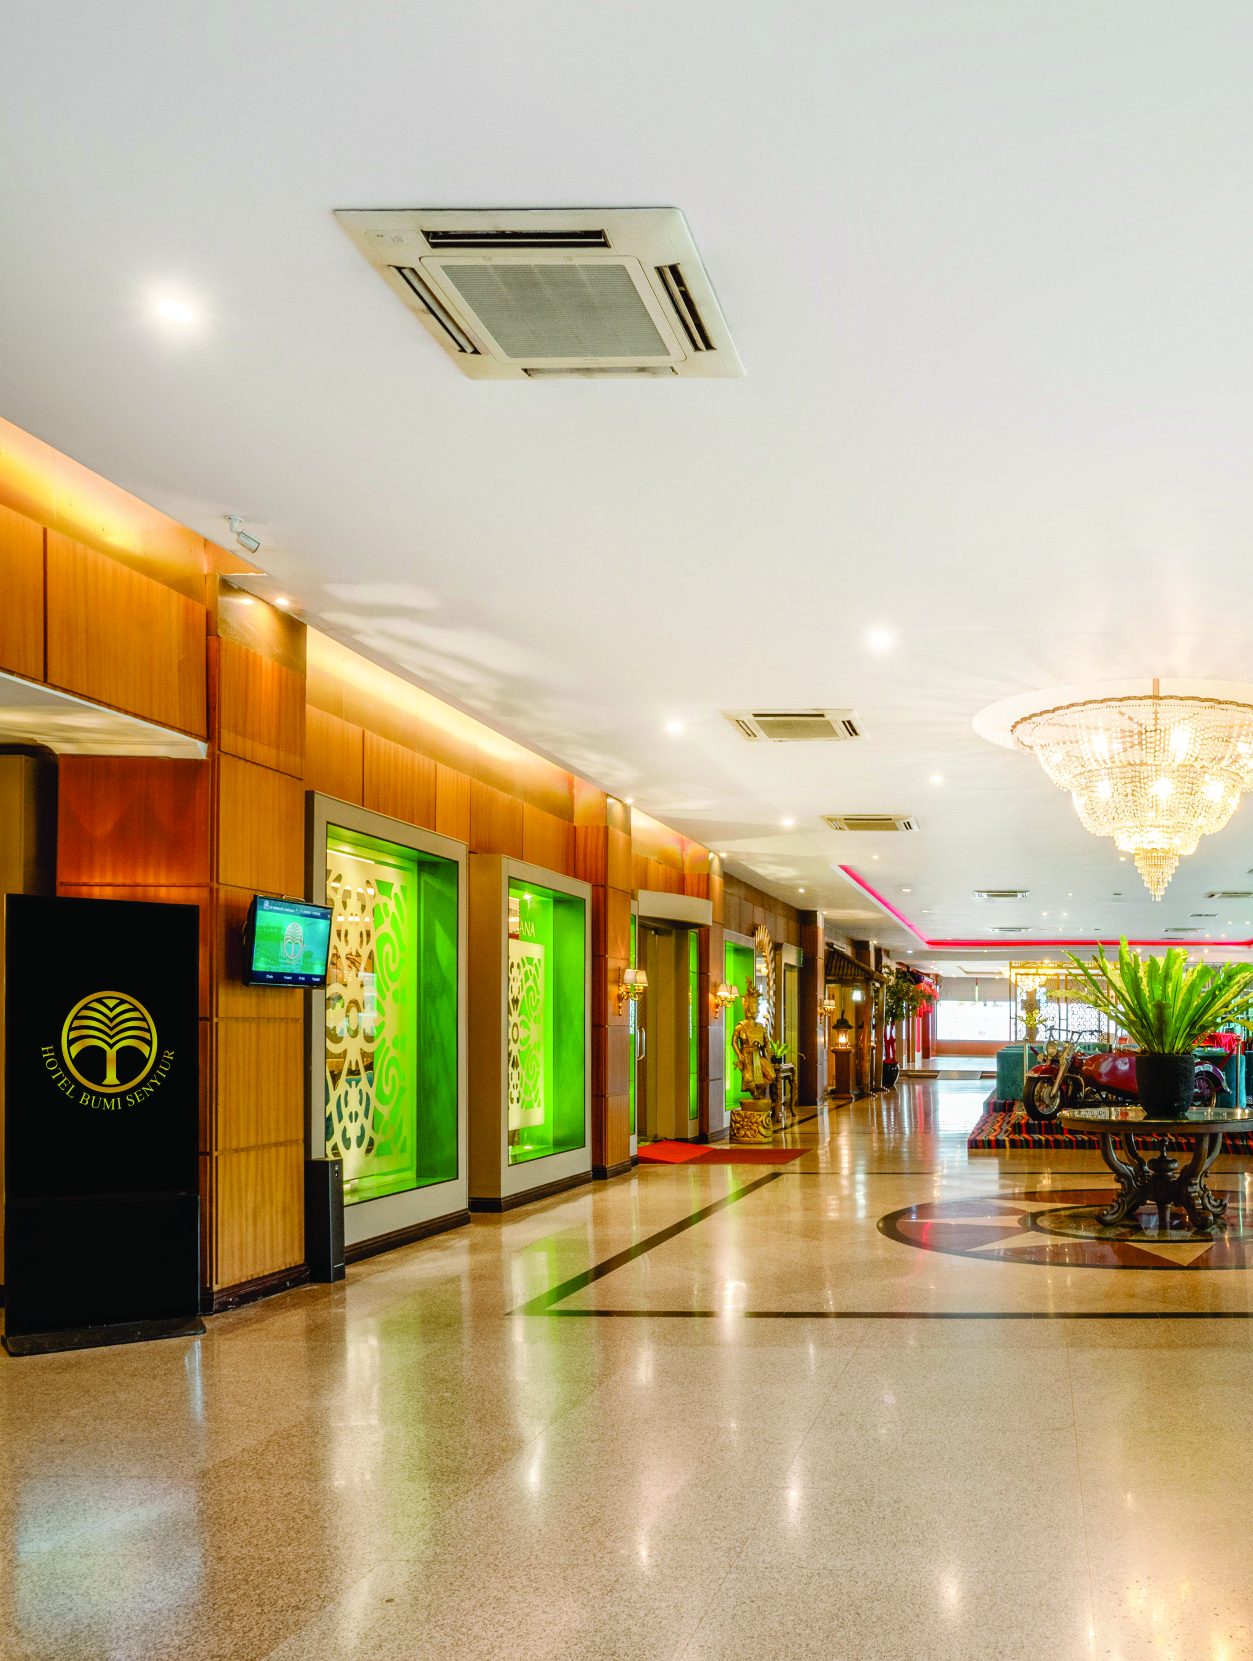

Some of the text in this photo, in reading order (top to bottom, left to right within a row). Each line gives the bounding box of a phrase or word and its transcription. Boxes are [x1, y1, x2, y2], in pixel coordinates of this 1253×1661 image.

[41, 1045, 175, 1110] HOTEL BUMI SENYIUR
